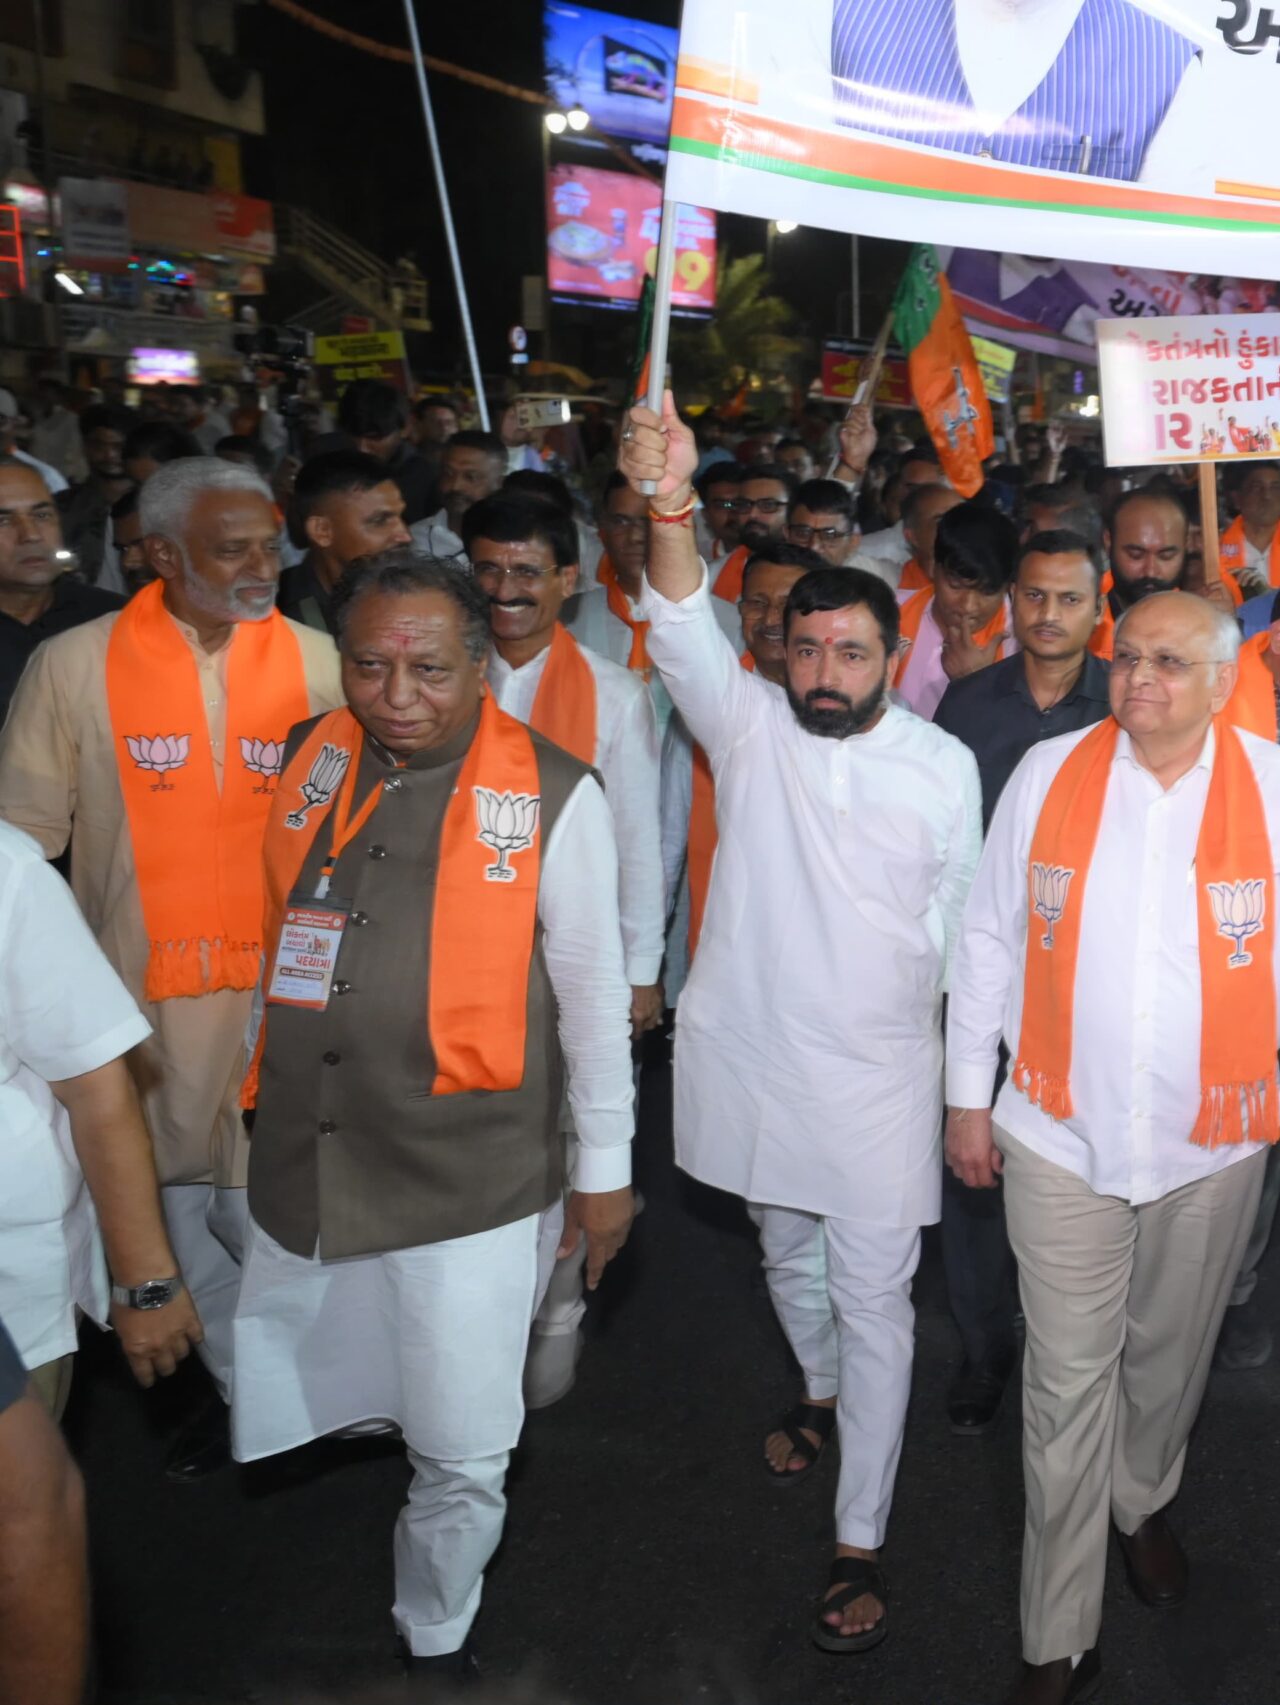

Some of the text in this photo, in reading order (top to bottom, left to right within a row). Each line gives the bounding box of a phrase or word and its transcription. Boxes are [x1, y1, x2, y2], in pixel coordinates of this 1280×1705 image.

[1124, 327, 1230, 361] ોકતંત્રનો
[1153, 412, 1193, 450] ાર
[295, 954, 331, 969] પદયાત્રા
